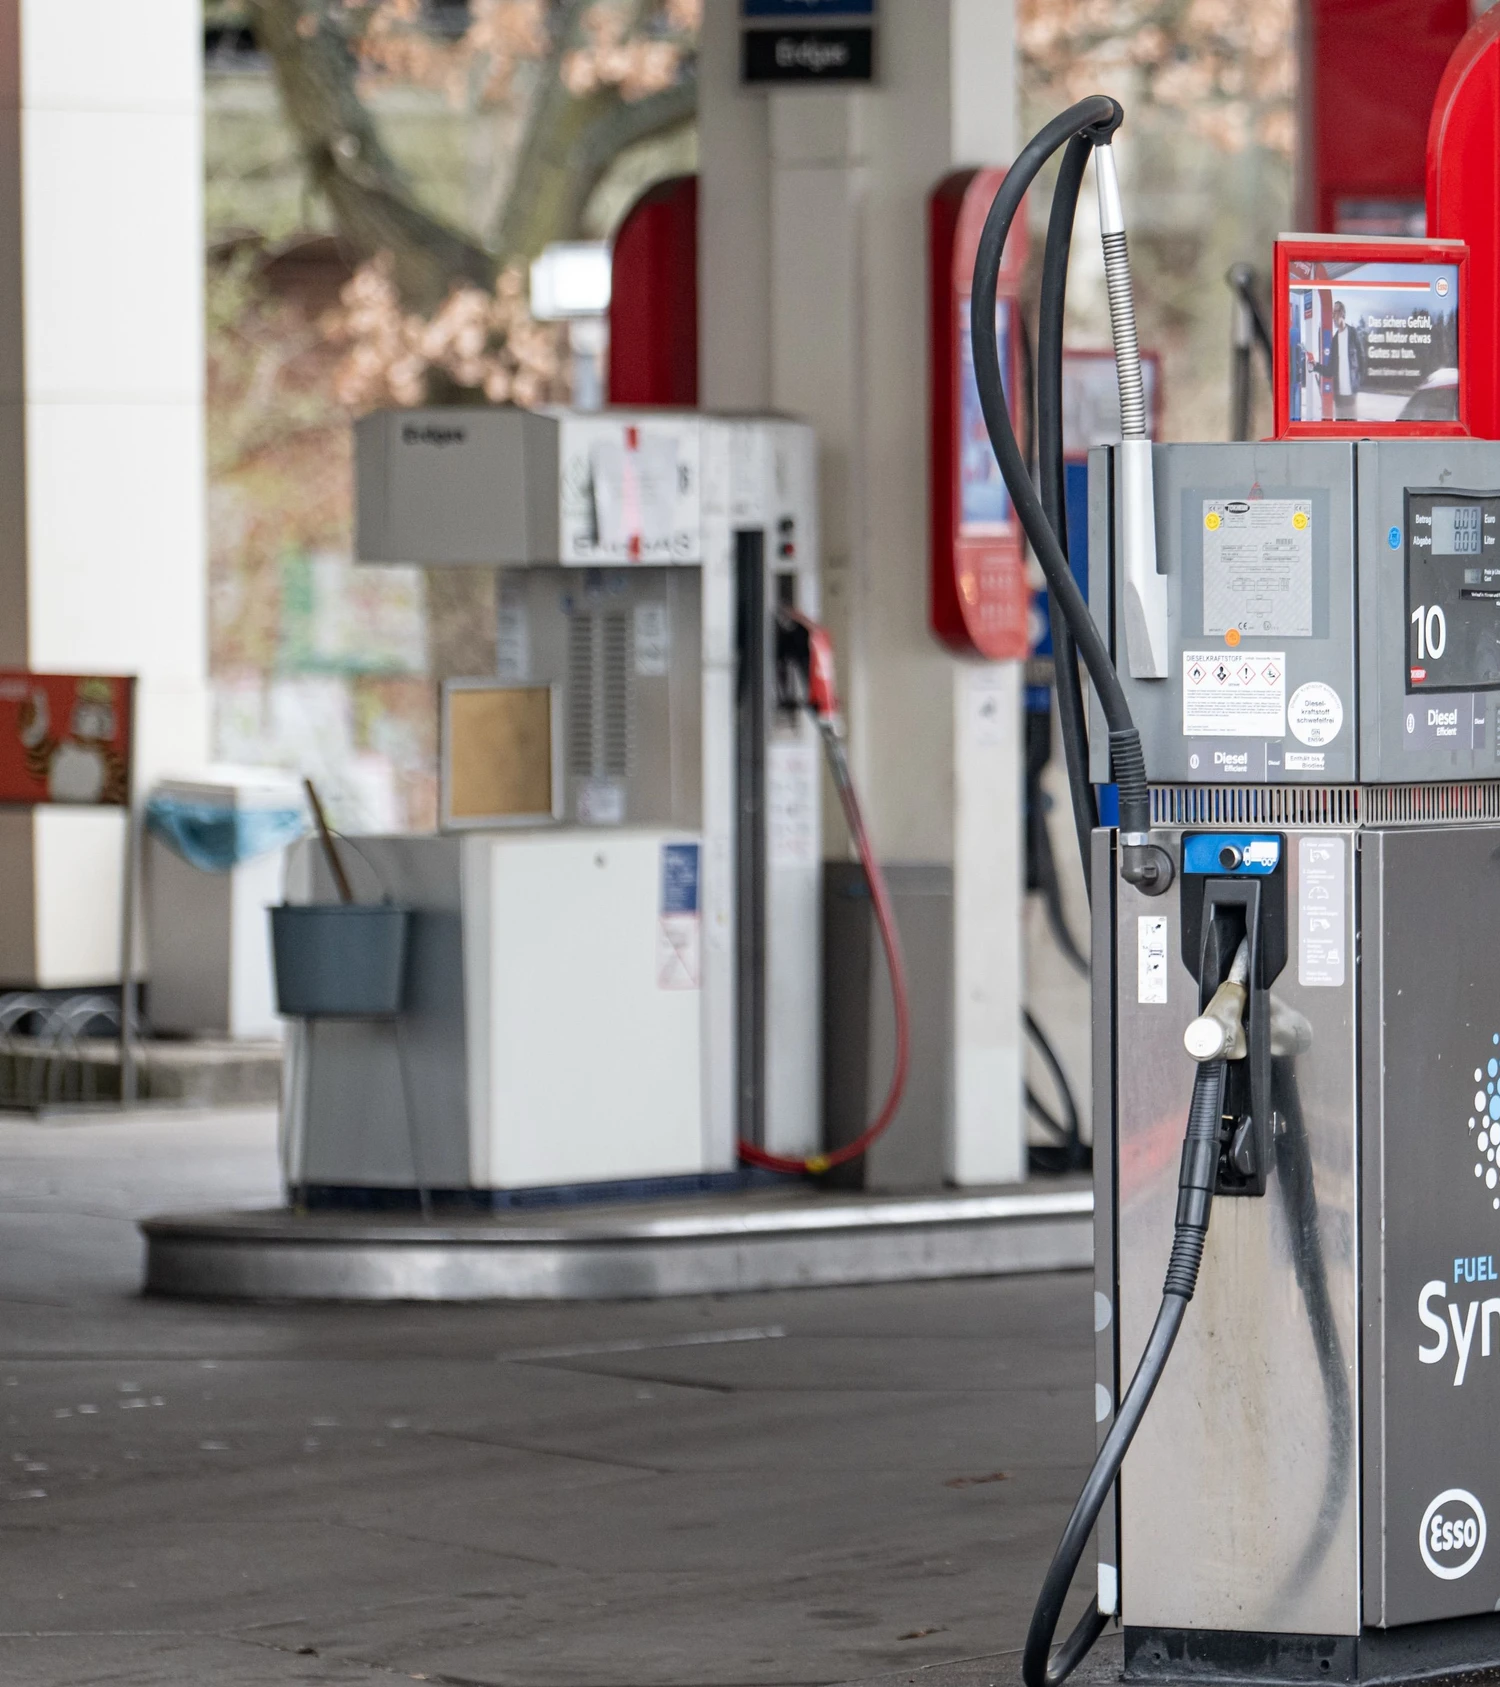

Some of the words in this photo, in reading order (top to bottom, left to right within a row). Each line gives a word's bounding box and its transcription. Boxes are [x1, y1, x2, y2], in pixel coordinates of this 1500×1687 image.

[1368, 316, 1381, 328] Das
[1382, 316, 1406, 328] sichere
[1407, 316, 1433, 330] Gefühl,
[1368, 332, 1385, 343] dem
[1386, 331, 1408, 343] Motor
[1409, 333, 1431, 344] etwas
[1368, 347, 1390, 359] Gutes
[1416, 514, 1432, 526] Betrag
[1484, 514, 1495, 524] Euro
[1413, 536, 1432, 547] Abgabe
[1484, 536, 1495, 546] Liter
[1411, 604, 1446, 660] 10
[1427, 709, 1457, 726] Diesel
[1436, 727, 1457, 736] Efficient
[1214, 752, 1248, 765] Diesel
[1454, 1256, 1498, 1283] FUEL
[1430, 1514, 1477, 1552] Esso
